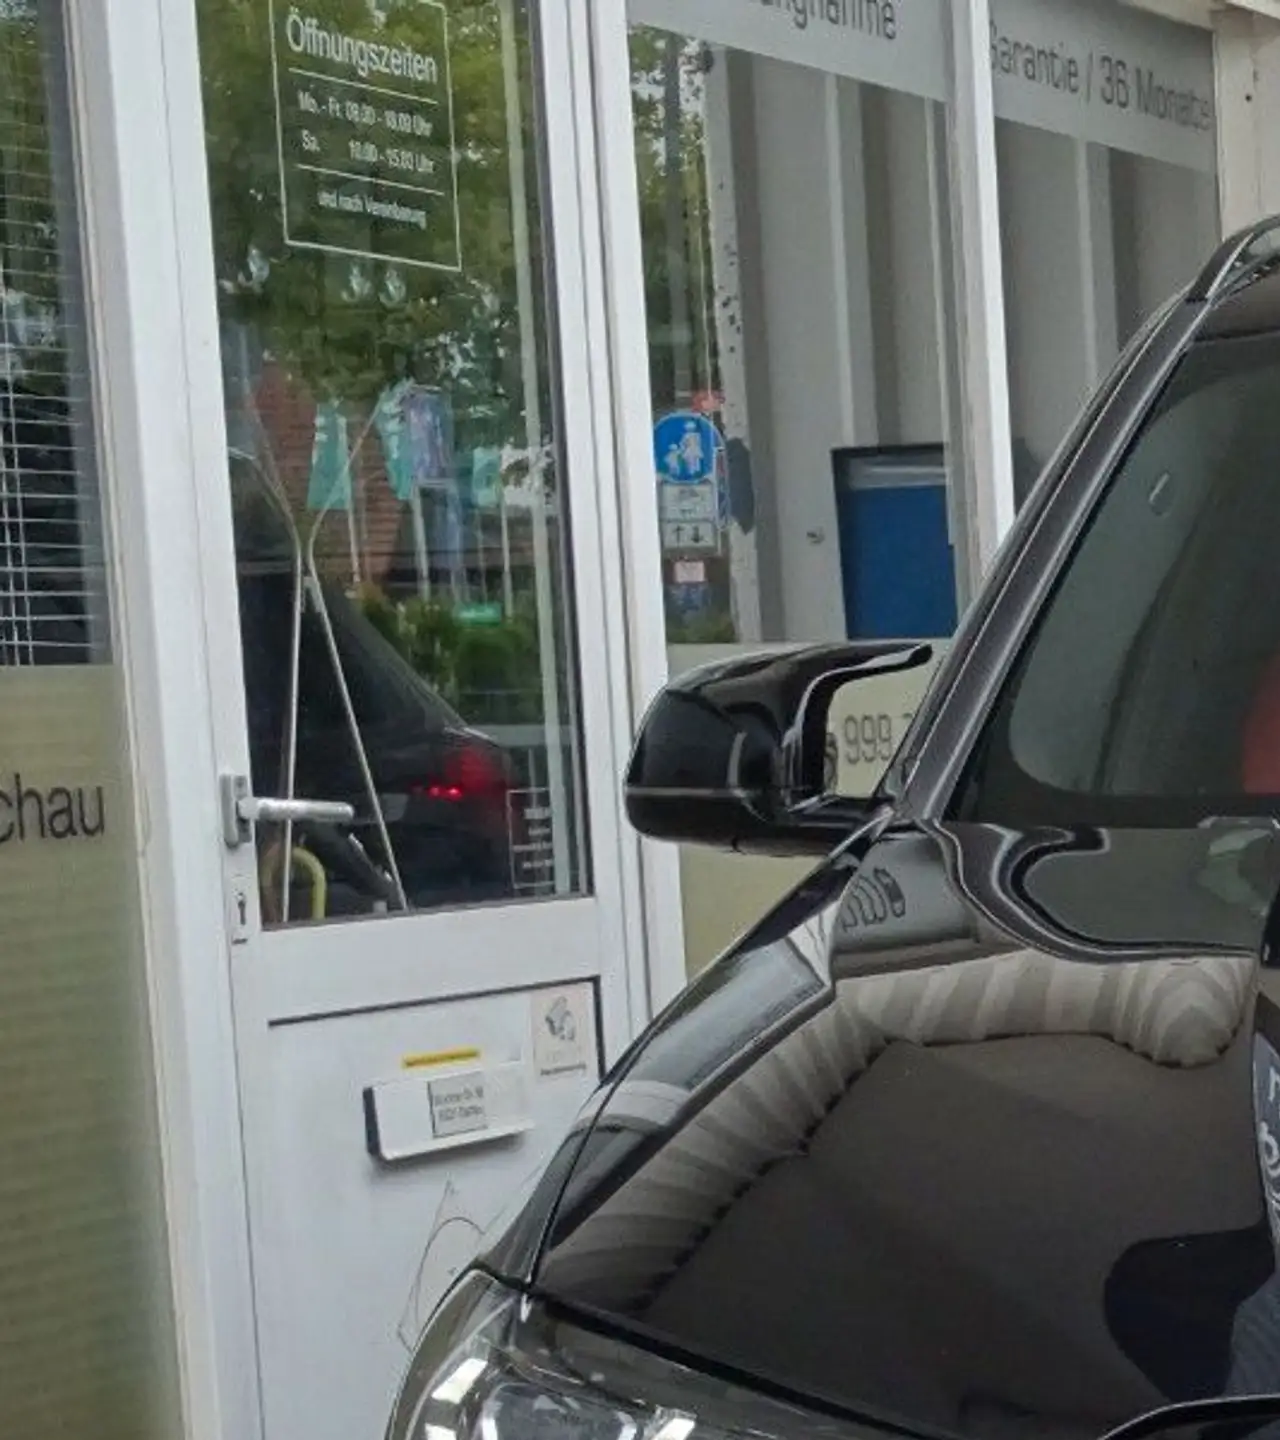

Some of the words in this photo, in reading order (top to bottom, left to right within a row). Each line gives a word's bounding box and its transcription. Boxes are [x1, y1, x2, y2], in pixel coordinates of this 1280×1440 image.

[286, 6, 437, 84] Öffnungszeiten
[1101, 55, 1129, 109] 36
[1135, 66, 1212, 132] Monate
